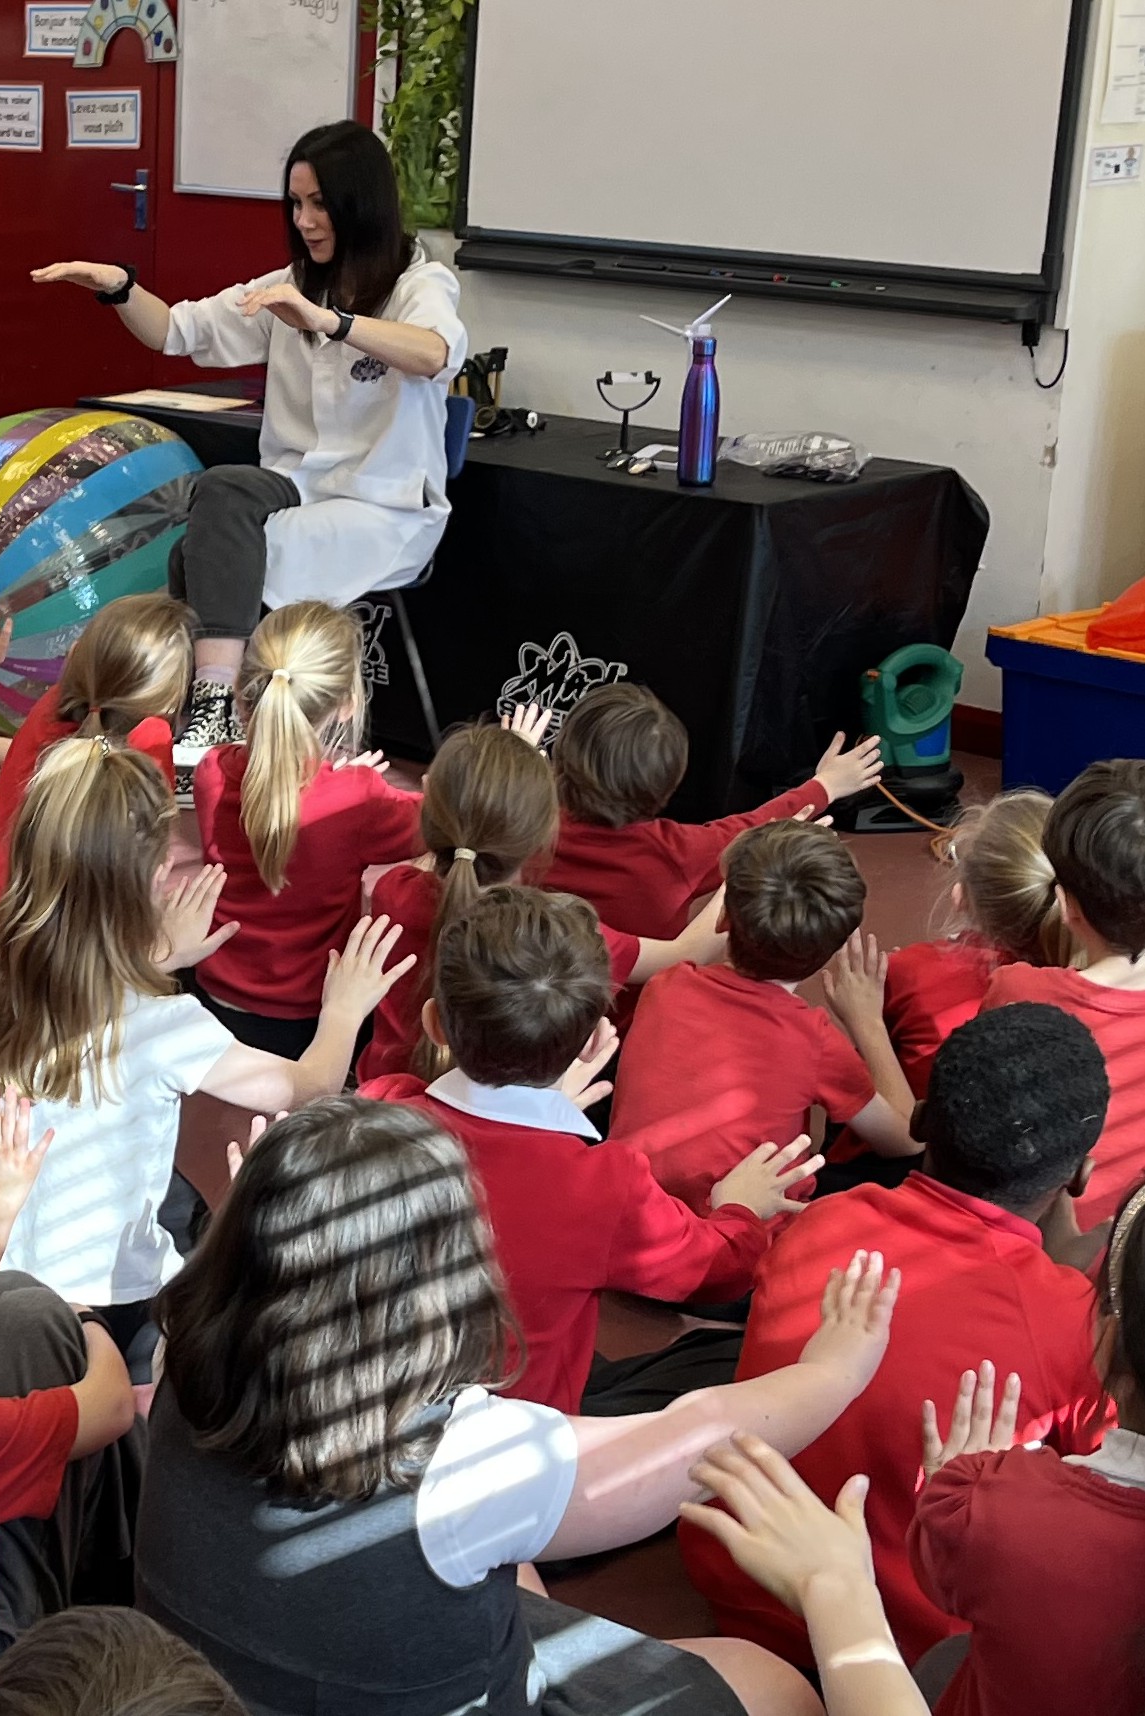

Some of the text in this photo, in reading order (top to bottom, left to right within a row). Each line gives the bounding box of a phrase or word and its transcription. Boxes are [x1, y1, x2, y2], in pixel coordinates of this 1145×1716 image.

[35, 14, 85, 30] Bonjour tou
[41, 35, 79, 46] le monde
[70, 102, 119, 114] Levez-vous
[83, 123, 103, 133] vous
